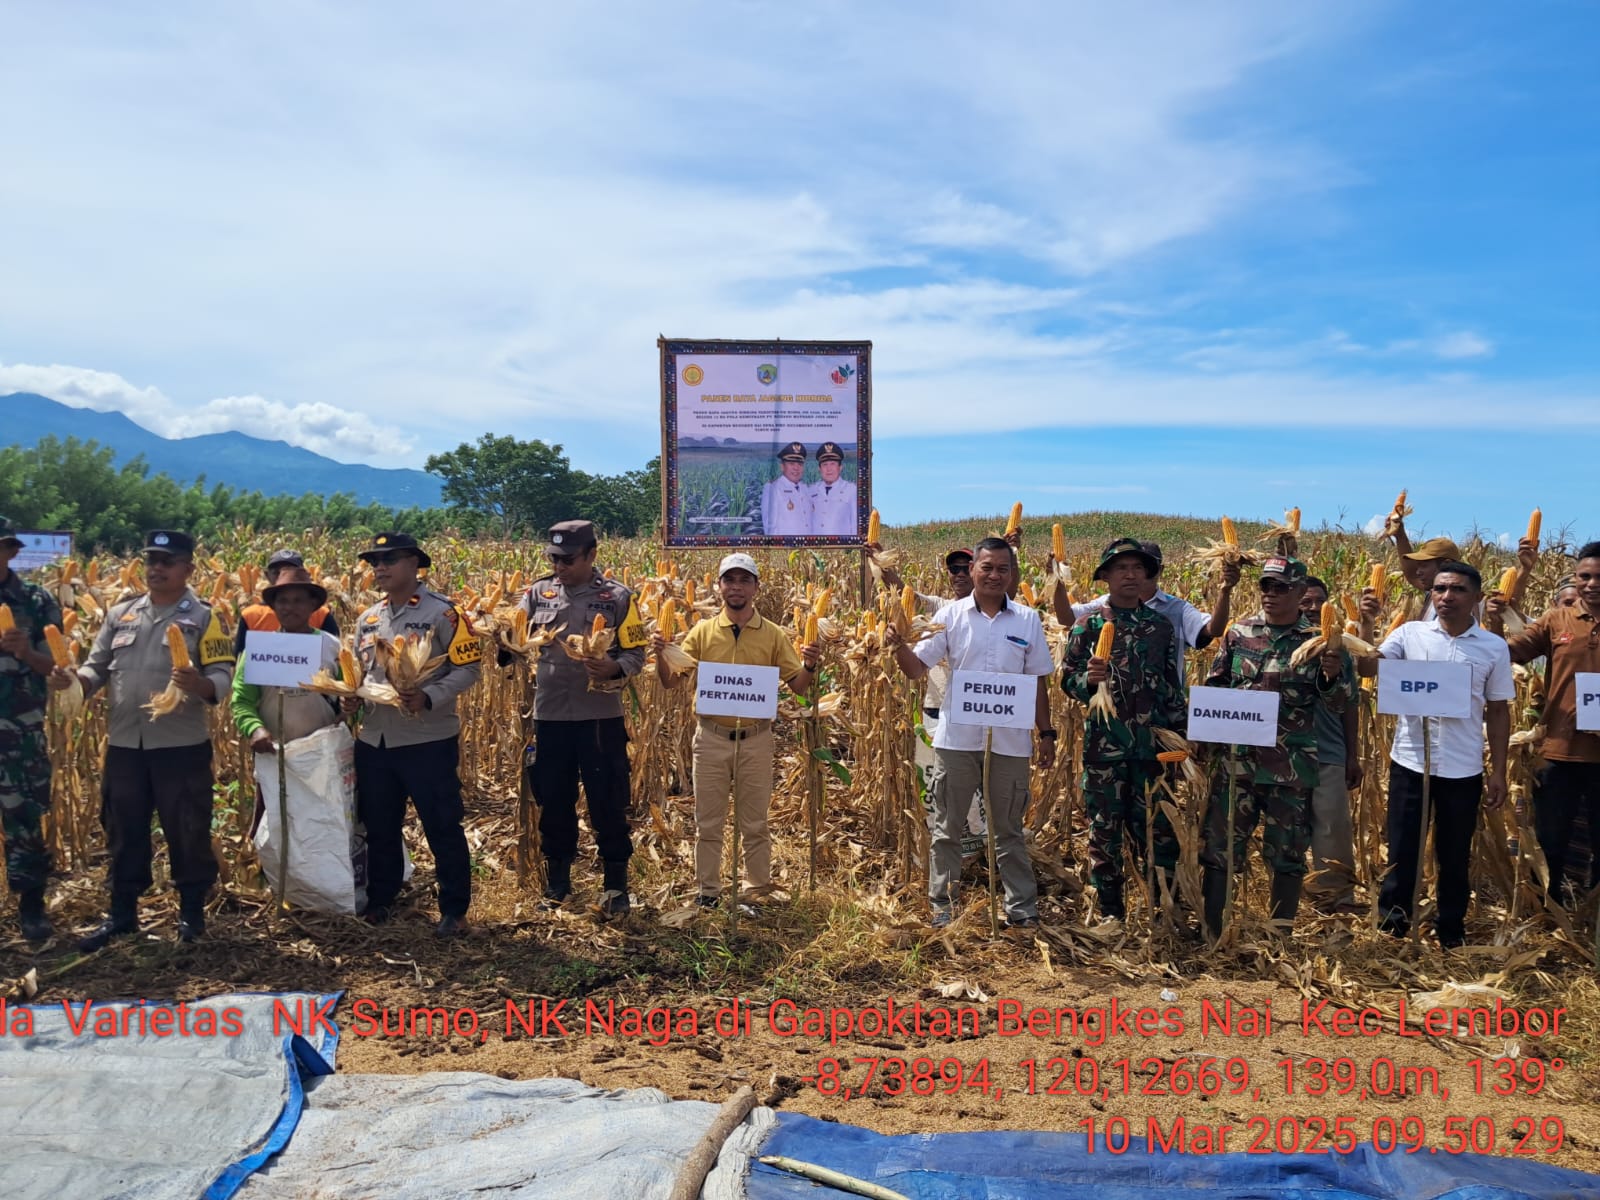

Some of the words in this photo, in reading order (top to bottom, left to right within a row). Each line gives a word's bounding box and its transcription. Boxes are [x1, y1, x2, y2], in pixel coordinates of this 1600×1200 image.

[404, 622, 431, 631] POLRI
[250, 653, 309, 665] KAPOLSEK
[714, 675, 753, 686] DINAS
[1400, 680, 1439, 693] BPP
[963, 682, 1016, 696] PERUM
[700, 690, 766, 702] PERTANIAN
[963, 702, 1015, 715] BULOK
[1193, 707, 1265, 722] DANRAMIL
